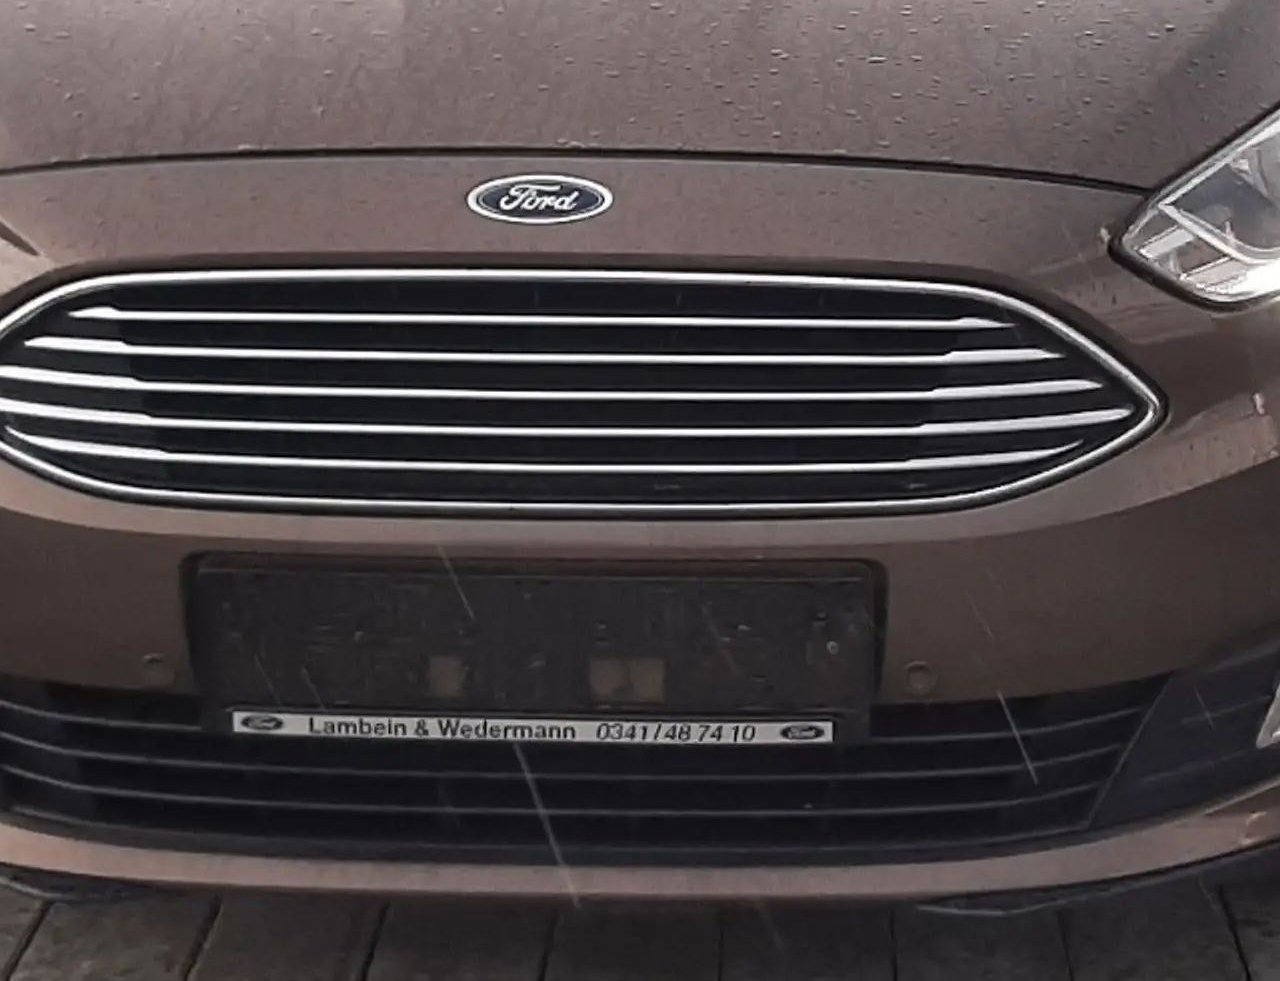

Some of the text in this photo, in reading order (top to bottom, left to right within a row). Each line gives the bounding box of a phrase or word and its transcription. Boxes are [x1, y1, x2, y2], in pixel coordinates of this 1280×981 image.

[499, 184, 579, 211] Ford
[308, 716, 756, 742] Lambein & Wedermann 0341/48 74 10
